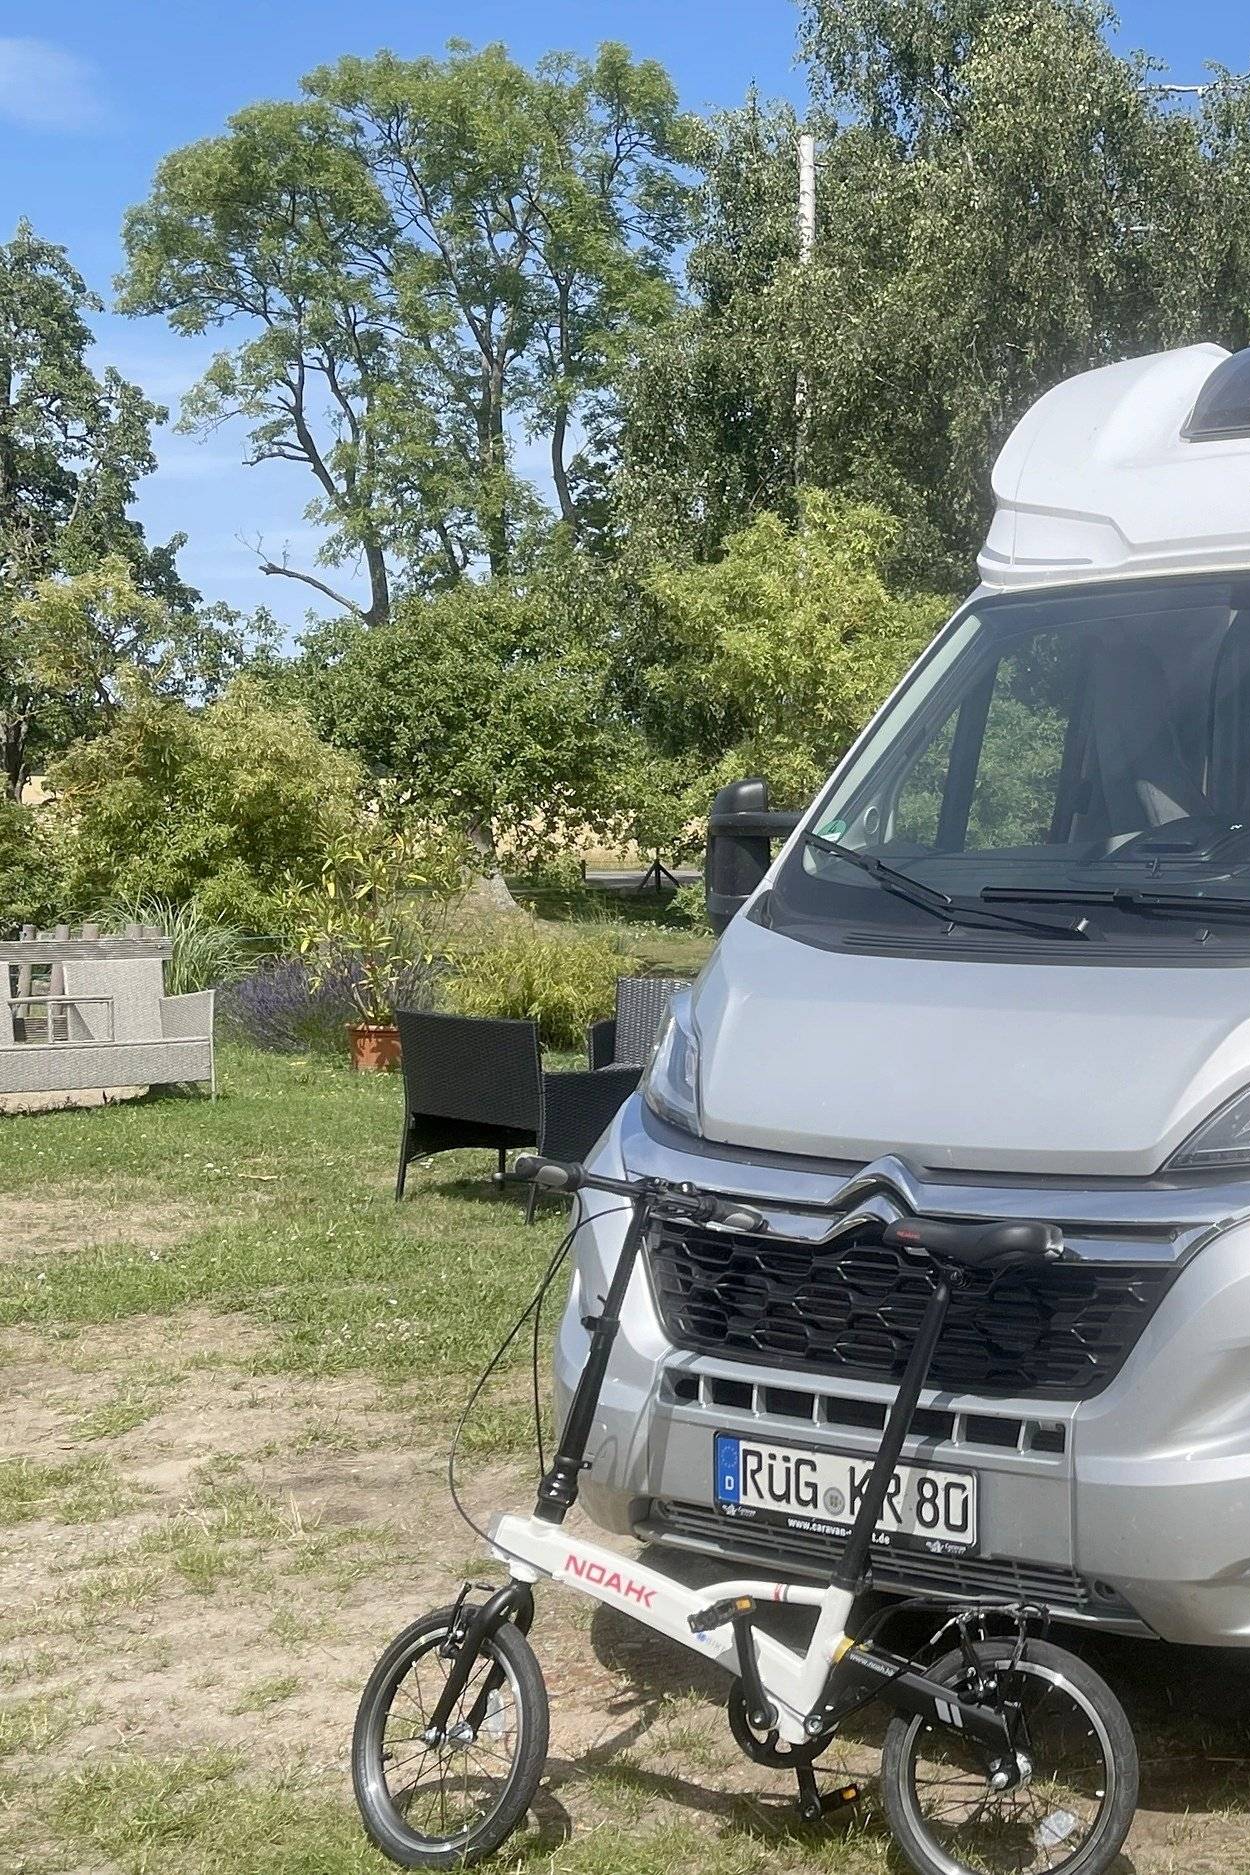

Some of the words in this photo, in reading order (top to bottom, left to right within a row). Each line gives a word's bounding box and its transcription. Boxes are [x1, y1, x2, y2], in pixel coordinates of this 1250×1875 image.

[724, 1475, 735, 1491] D
[741, 1447, 818, 1509] RÜG
[849, 1465, 903, 1524] KR
[915, 1476, 969, 1533] 80
